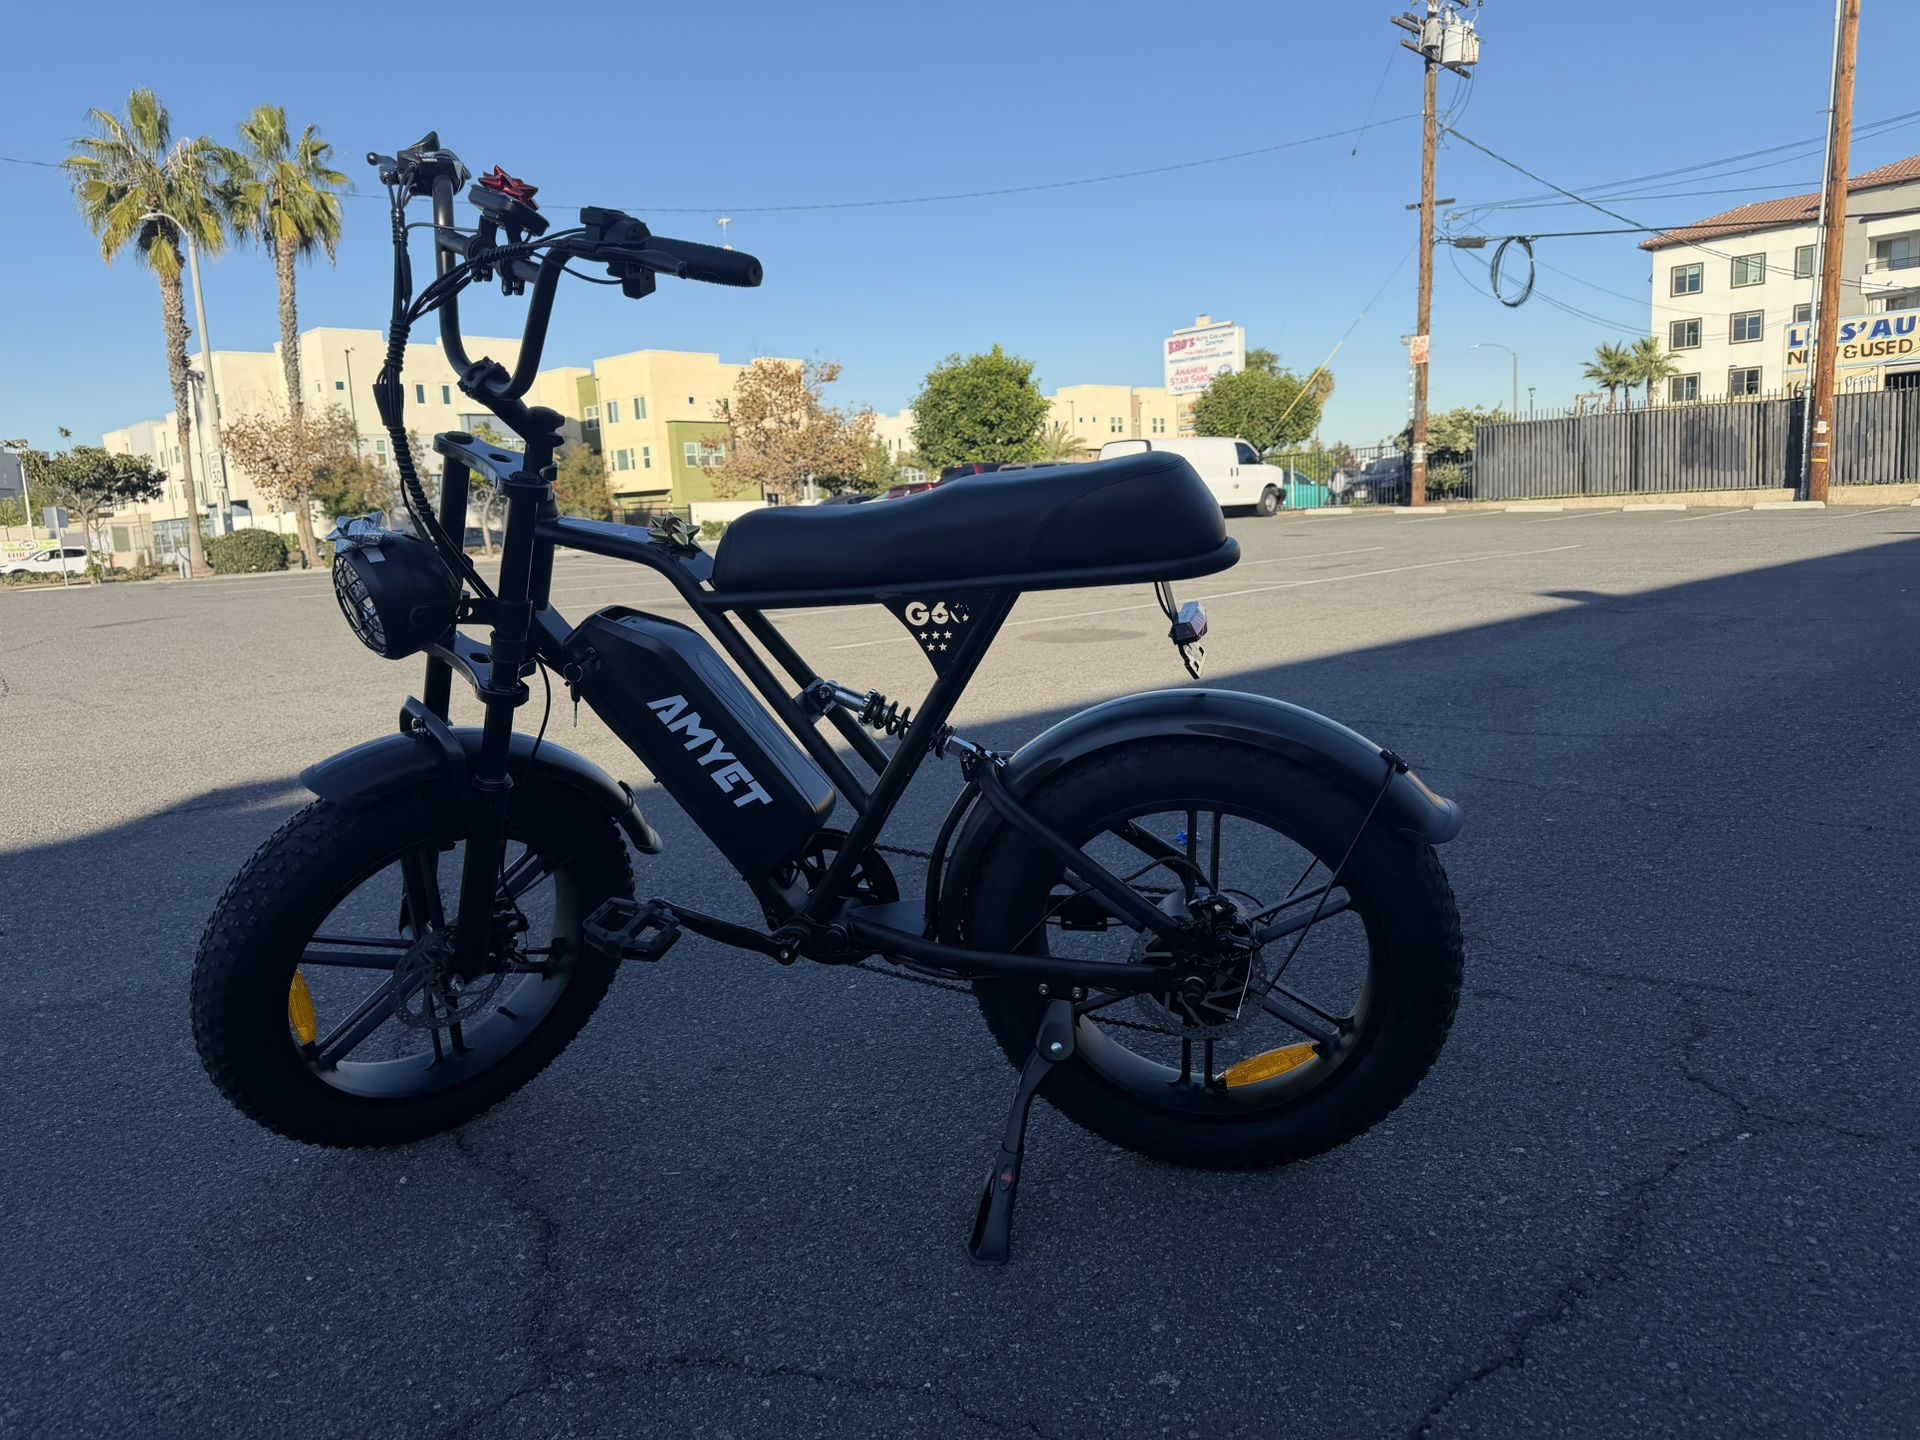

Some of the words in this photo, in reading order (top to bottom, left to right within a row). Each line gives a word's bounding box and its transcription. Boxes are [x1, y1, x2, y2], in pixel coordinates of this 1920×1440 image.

[1843, 345, 1858, 359] &
[1860, 338, 1913, 357] USED
[1175, 366, 1208, 378] ANAHEIM
[646, 694, 774, 808] AMYET
